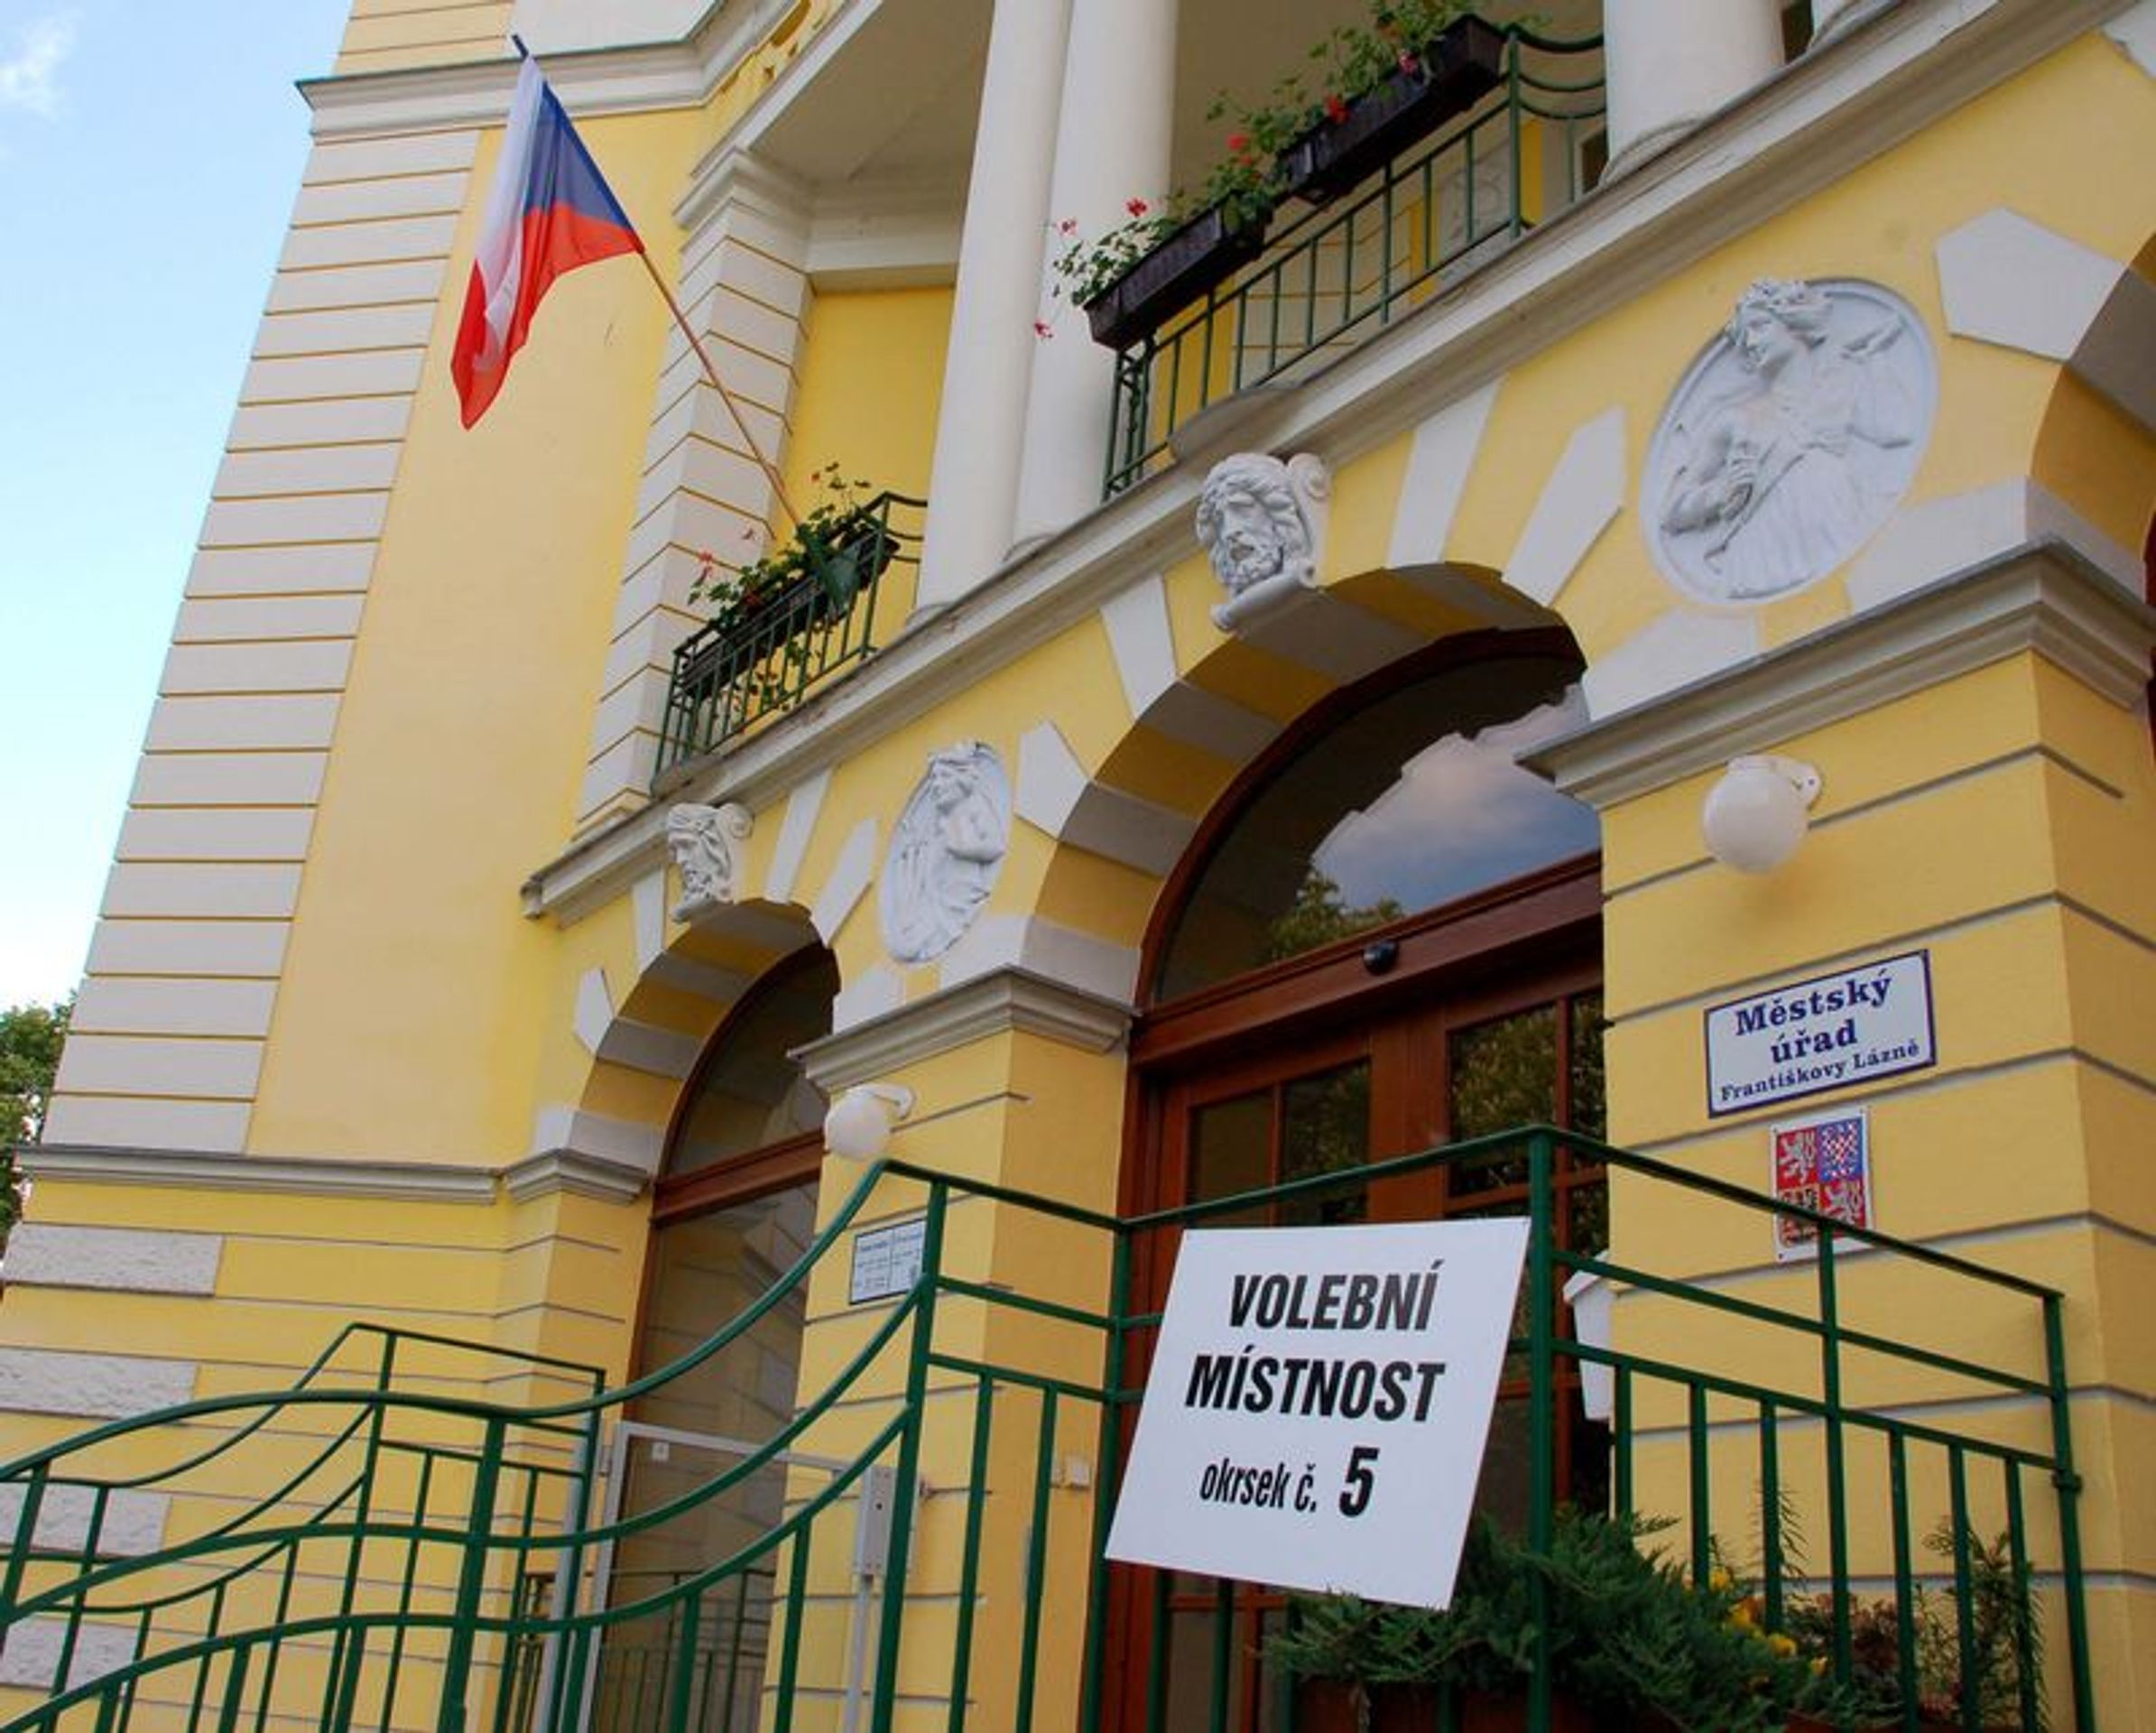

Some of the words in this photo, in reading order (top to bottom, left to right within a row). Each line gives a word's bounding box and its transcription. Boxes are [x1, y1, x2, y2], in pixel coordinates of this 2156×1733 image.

[1735, 968, 1892, 1035] Městský
[1721, 1061, 1846, 1100] Františkovy
[1853, 1039, 1920, 1069] Lázně
[1771, 1019, 1857, 1063] úřad
[1229, 1260, 1444, 1330] VOLEBNÍ
[1185, 1345, 1445, 1422] MÍSTNOST
[1199, 1458, 1291, 1509] okrsek
[1295, 1463, 1318, 1513] č.
[1339, 1446, 1379, 1517] 5
